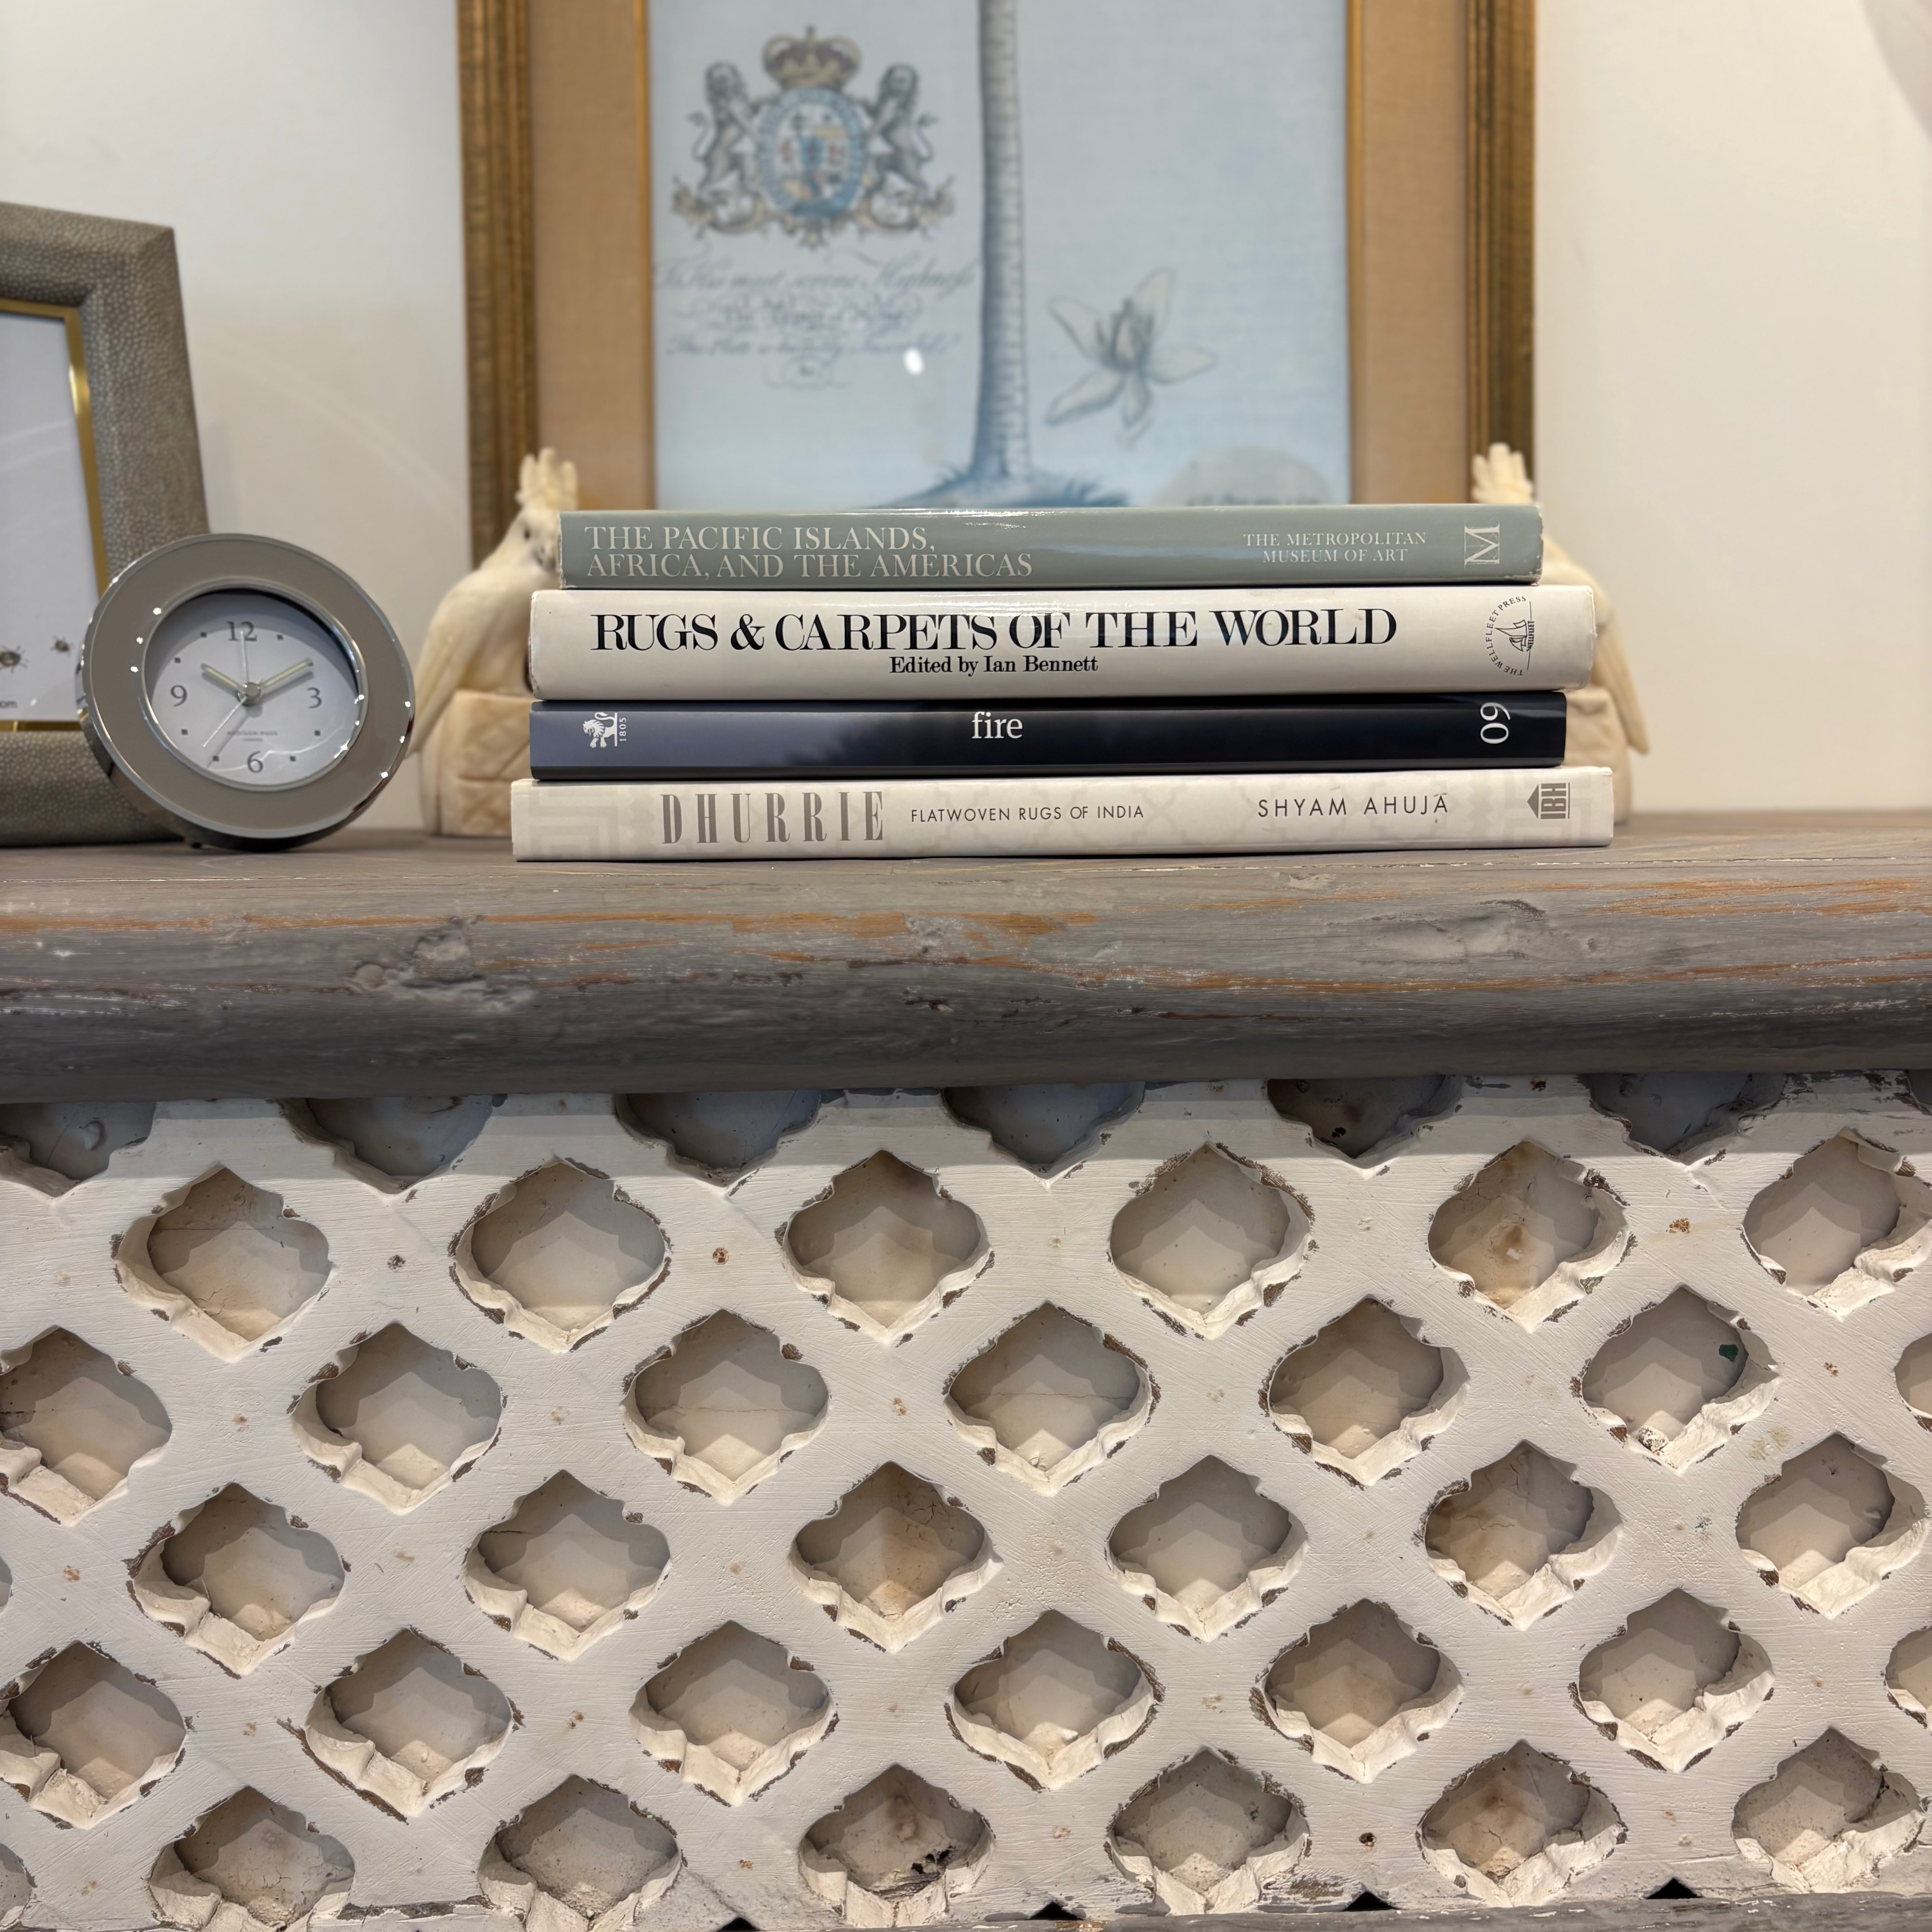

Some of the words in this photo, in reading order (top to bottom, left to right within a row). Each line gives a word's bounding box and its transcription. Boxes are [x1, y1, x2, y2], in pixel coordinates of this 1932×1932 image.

[584, 526, 653, 550] THE
[663, 526, 782, 550] PACIFIC
[794, 527, 934, 553] ISLANDS,
[1243, 534, 1280, 547] THE
[1286, 532, 1426, 546] METROPOLITAN
[587, 553, 709, 580] AFRICA,
[716, 554, 783, 577] AND
[794, 554, 861, 577] THE
[870, 553, 1032, 577] AMERICAS
[1263, 549, 1338, 562] MUSEUM
[1344, 549, 1367, 561] OF
[1373, 548, 1408, 561] ART
[1498, 596, 1527, 611] PRESS
[226, 621, 258, 642] 12
[590, 614, 718, 651] RUGS
[730, 614, 766, 651] &
[775, 614, 998, 651] CARPETS
[1009, 612, 1071, 650] OF
[1086, 611, 1198, 649] THE
[1208, 607, 1397, 647] WORLD
[1486, 610, 1503, 669] WELLFLEET
[889, 656, 953, 673] Edited
[957, 655, 979, 677] by
[983, 655, 1017, 672] Ian
[1023, 655, 1098, 672] Bennett
[1503, 665, 1523, 676] THE
[170, 684, 188, 708] 9
[307, 686, 322, 709] 3
[971, 711, 1023, 739] fire
[247, 751, 264, 773] 6
[1258, 797, 1347, 818] SHYAM
[1363, 795, 1448, 815] AHUJA
[1540, 782, 1567, 820] IBH
[660, 791, 884, 845] DHURRIE
[911, 807, 1010, 823] FLATWOVEN
[1019, 807, 1062, 821] RUGS
[1069, 806, 1089, 819] OF
[1097, 805, 1144, 819] INDIA
